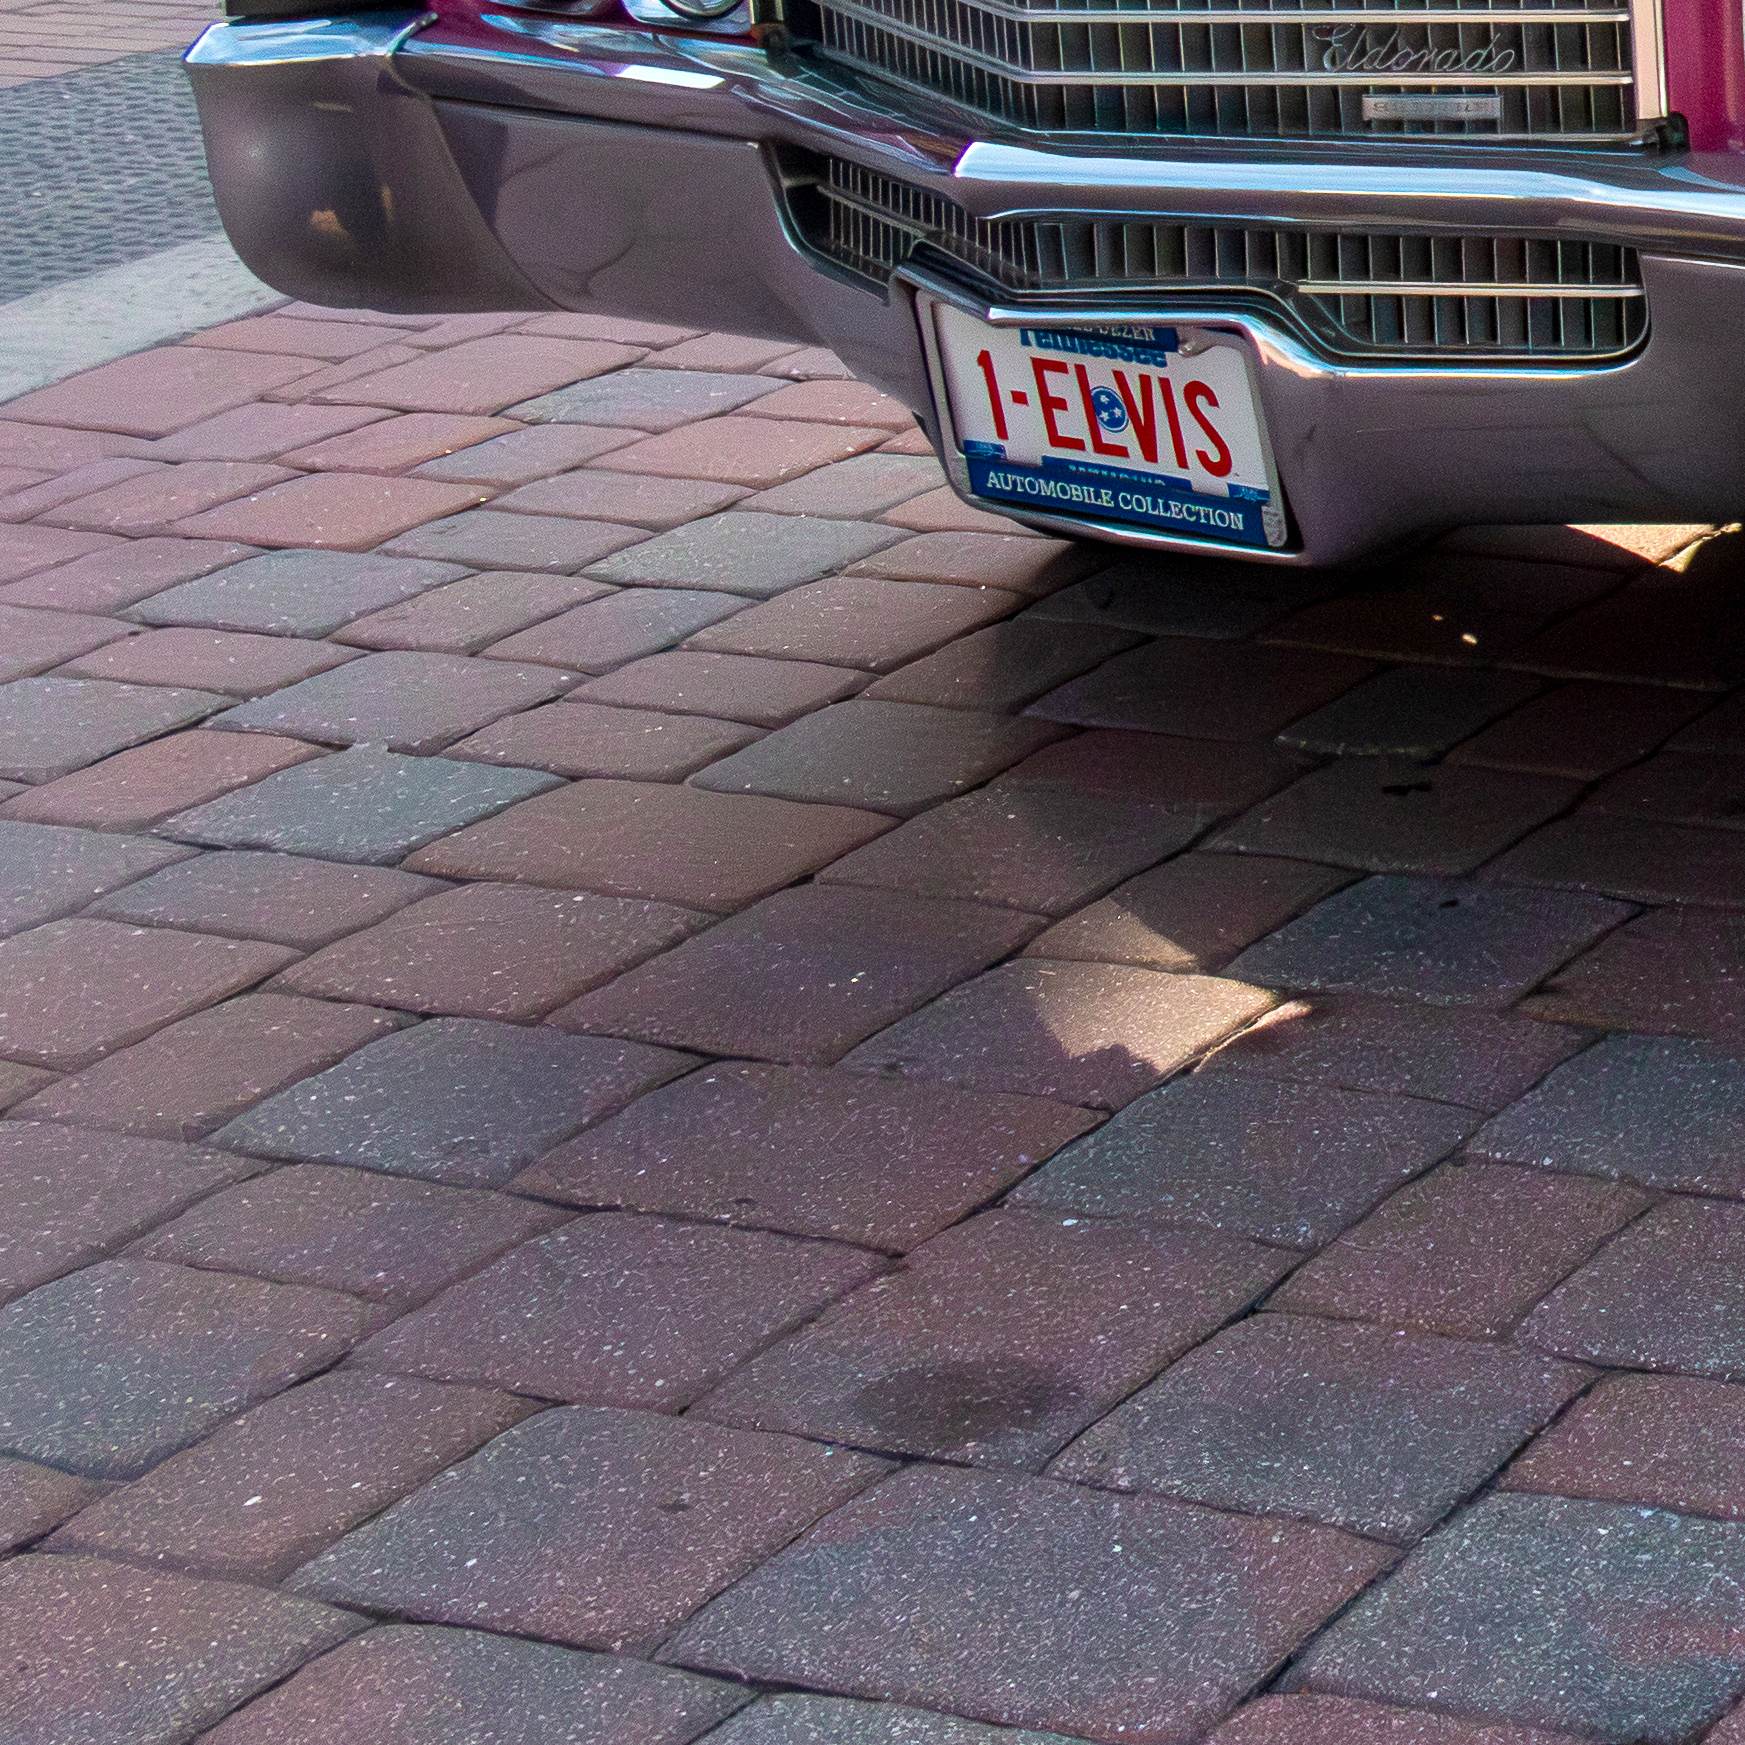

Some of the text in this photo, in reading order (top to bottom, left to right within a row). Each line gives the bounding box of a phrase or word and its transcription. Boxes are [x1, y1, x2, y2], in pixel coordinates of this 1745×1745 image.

[1312, 24, 1515, 73] Eldorado
[977, 349, 1233, 478] 1-ELVIS
[986, 469, 1115, 507] AUTOMOBILE
[1118, 491, 1244, 531] COLLECTION
